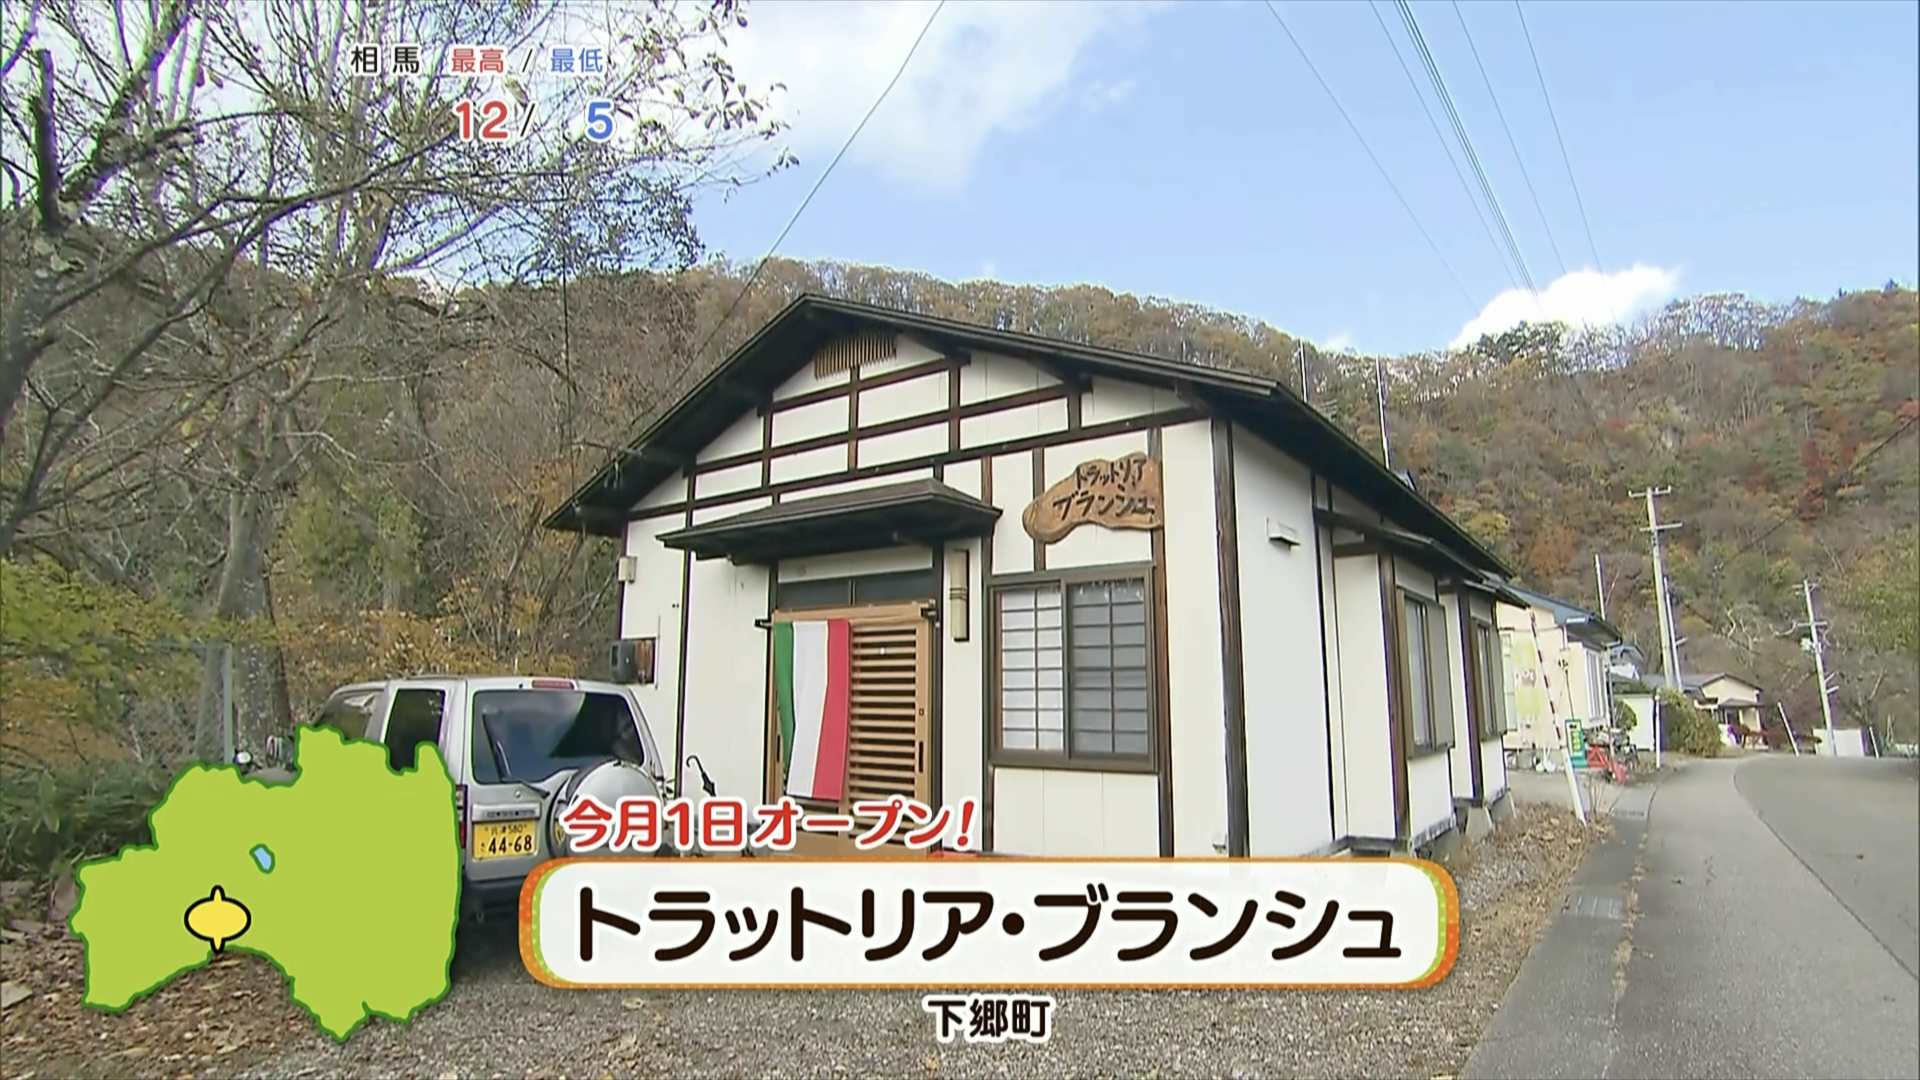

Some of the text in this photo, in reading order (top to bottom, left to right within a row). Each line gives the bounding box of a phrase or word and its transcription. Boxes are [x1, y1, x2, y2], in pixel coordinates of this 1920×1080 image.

[1076, 458, 1147, 490] トラットリア
[1052, 484, 1155, 521] ブランシュ
[488, 835, 532, 855] 44-68
